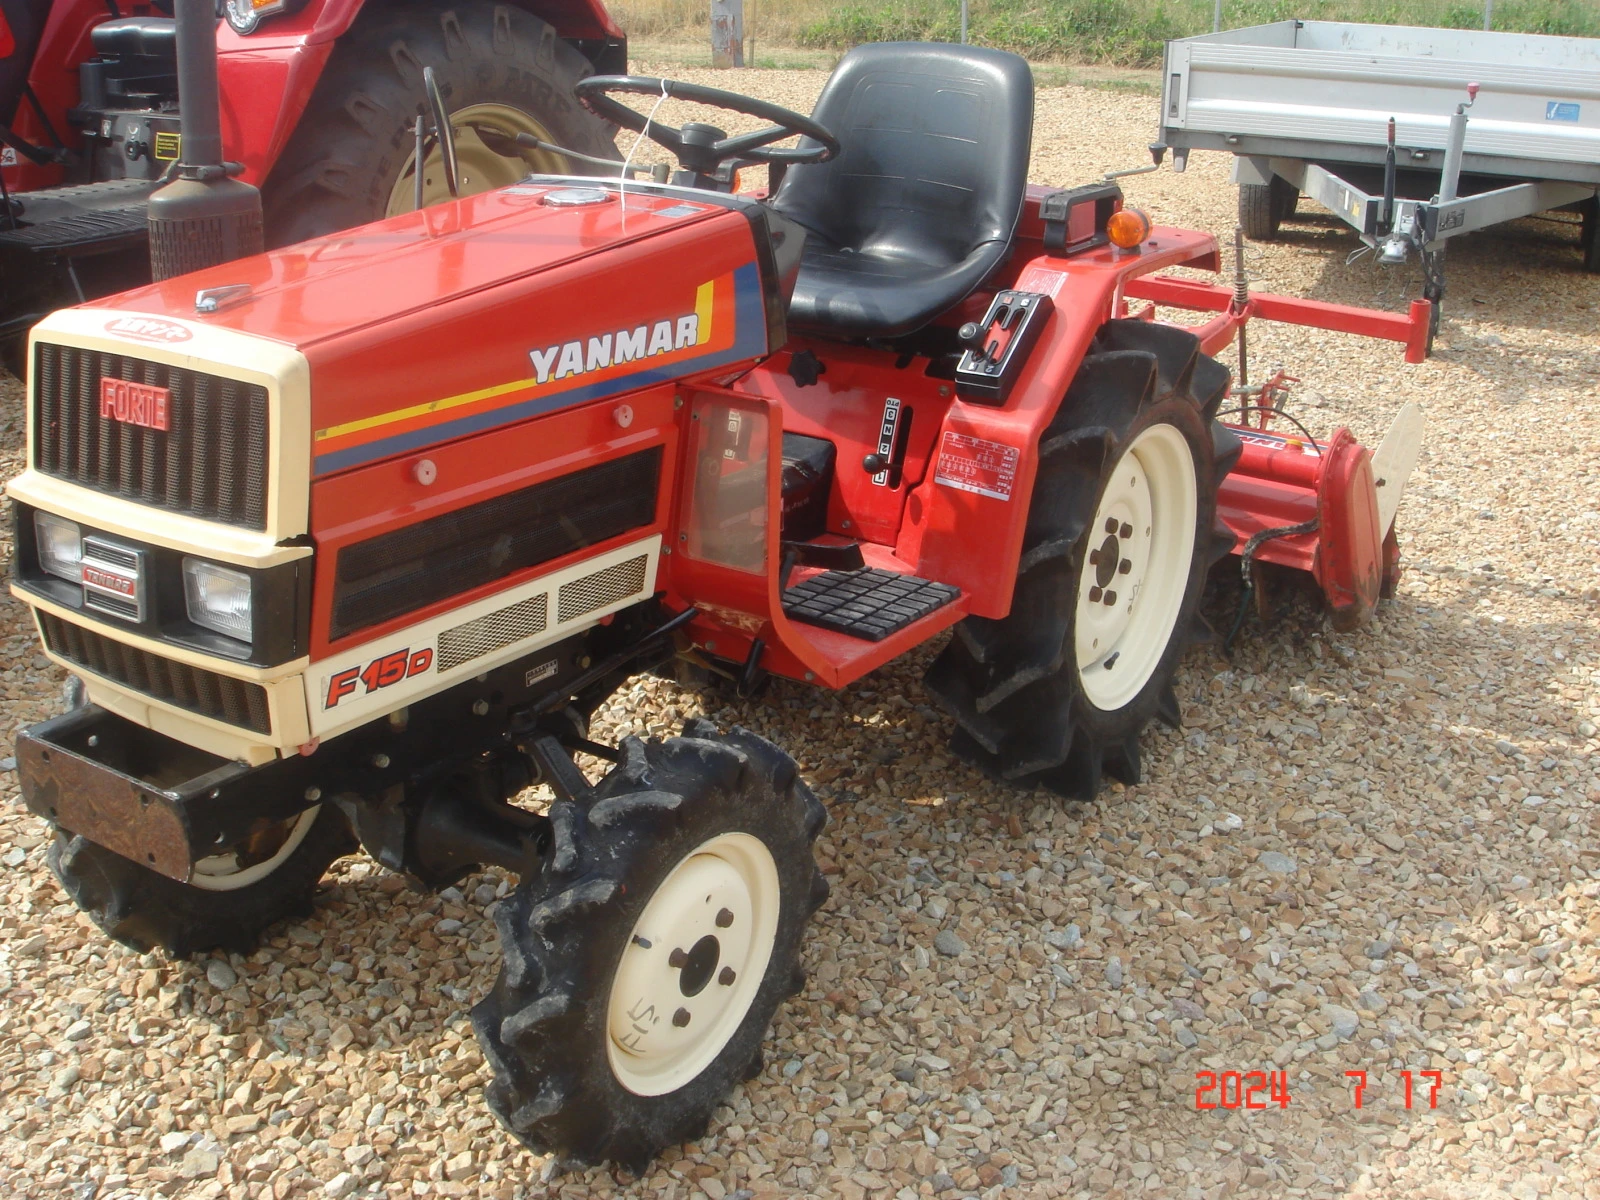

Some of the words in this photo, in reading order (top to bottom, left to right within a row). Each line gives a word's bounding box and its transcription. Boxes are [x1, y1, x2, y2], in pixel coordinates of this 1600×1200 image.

[529, 314, 698, 384] YANMAR
[102, 378, 167, 430] FORTE
[886, 399, 899, 407] PTO
[885, 426, 891, 434] N
